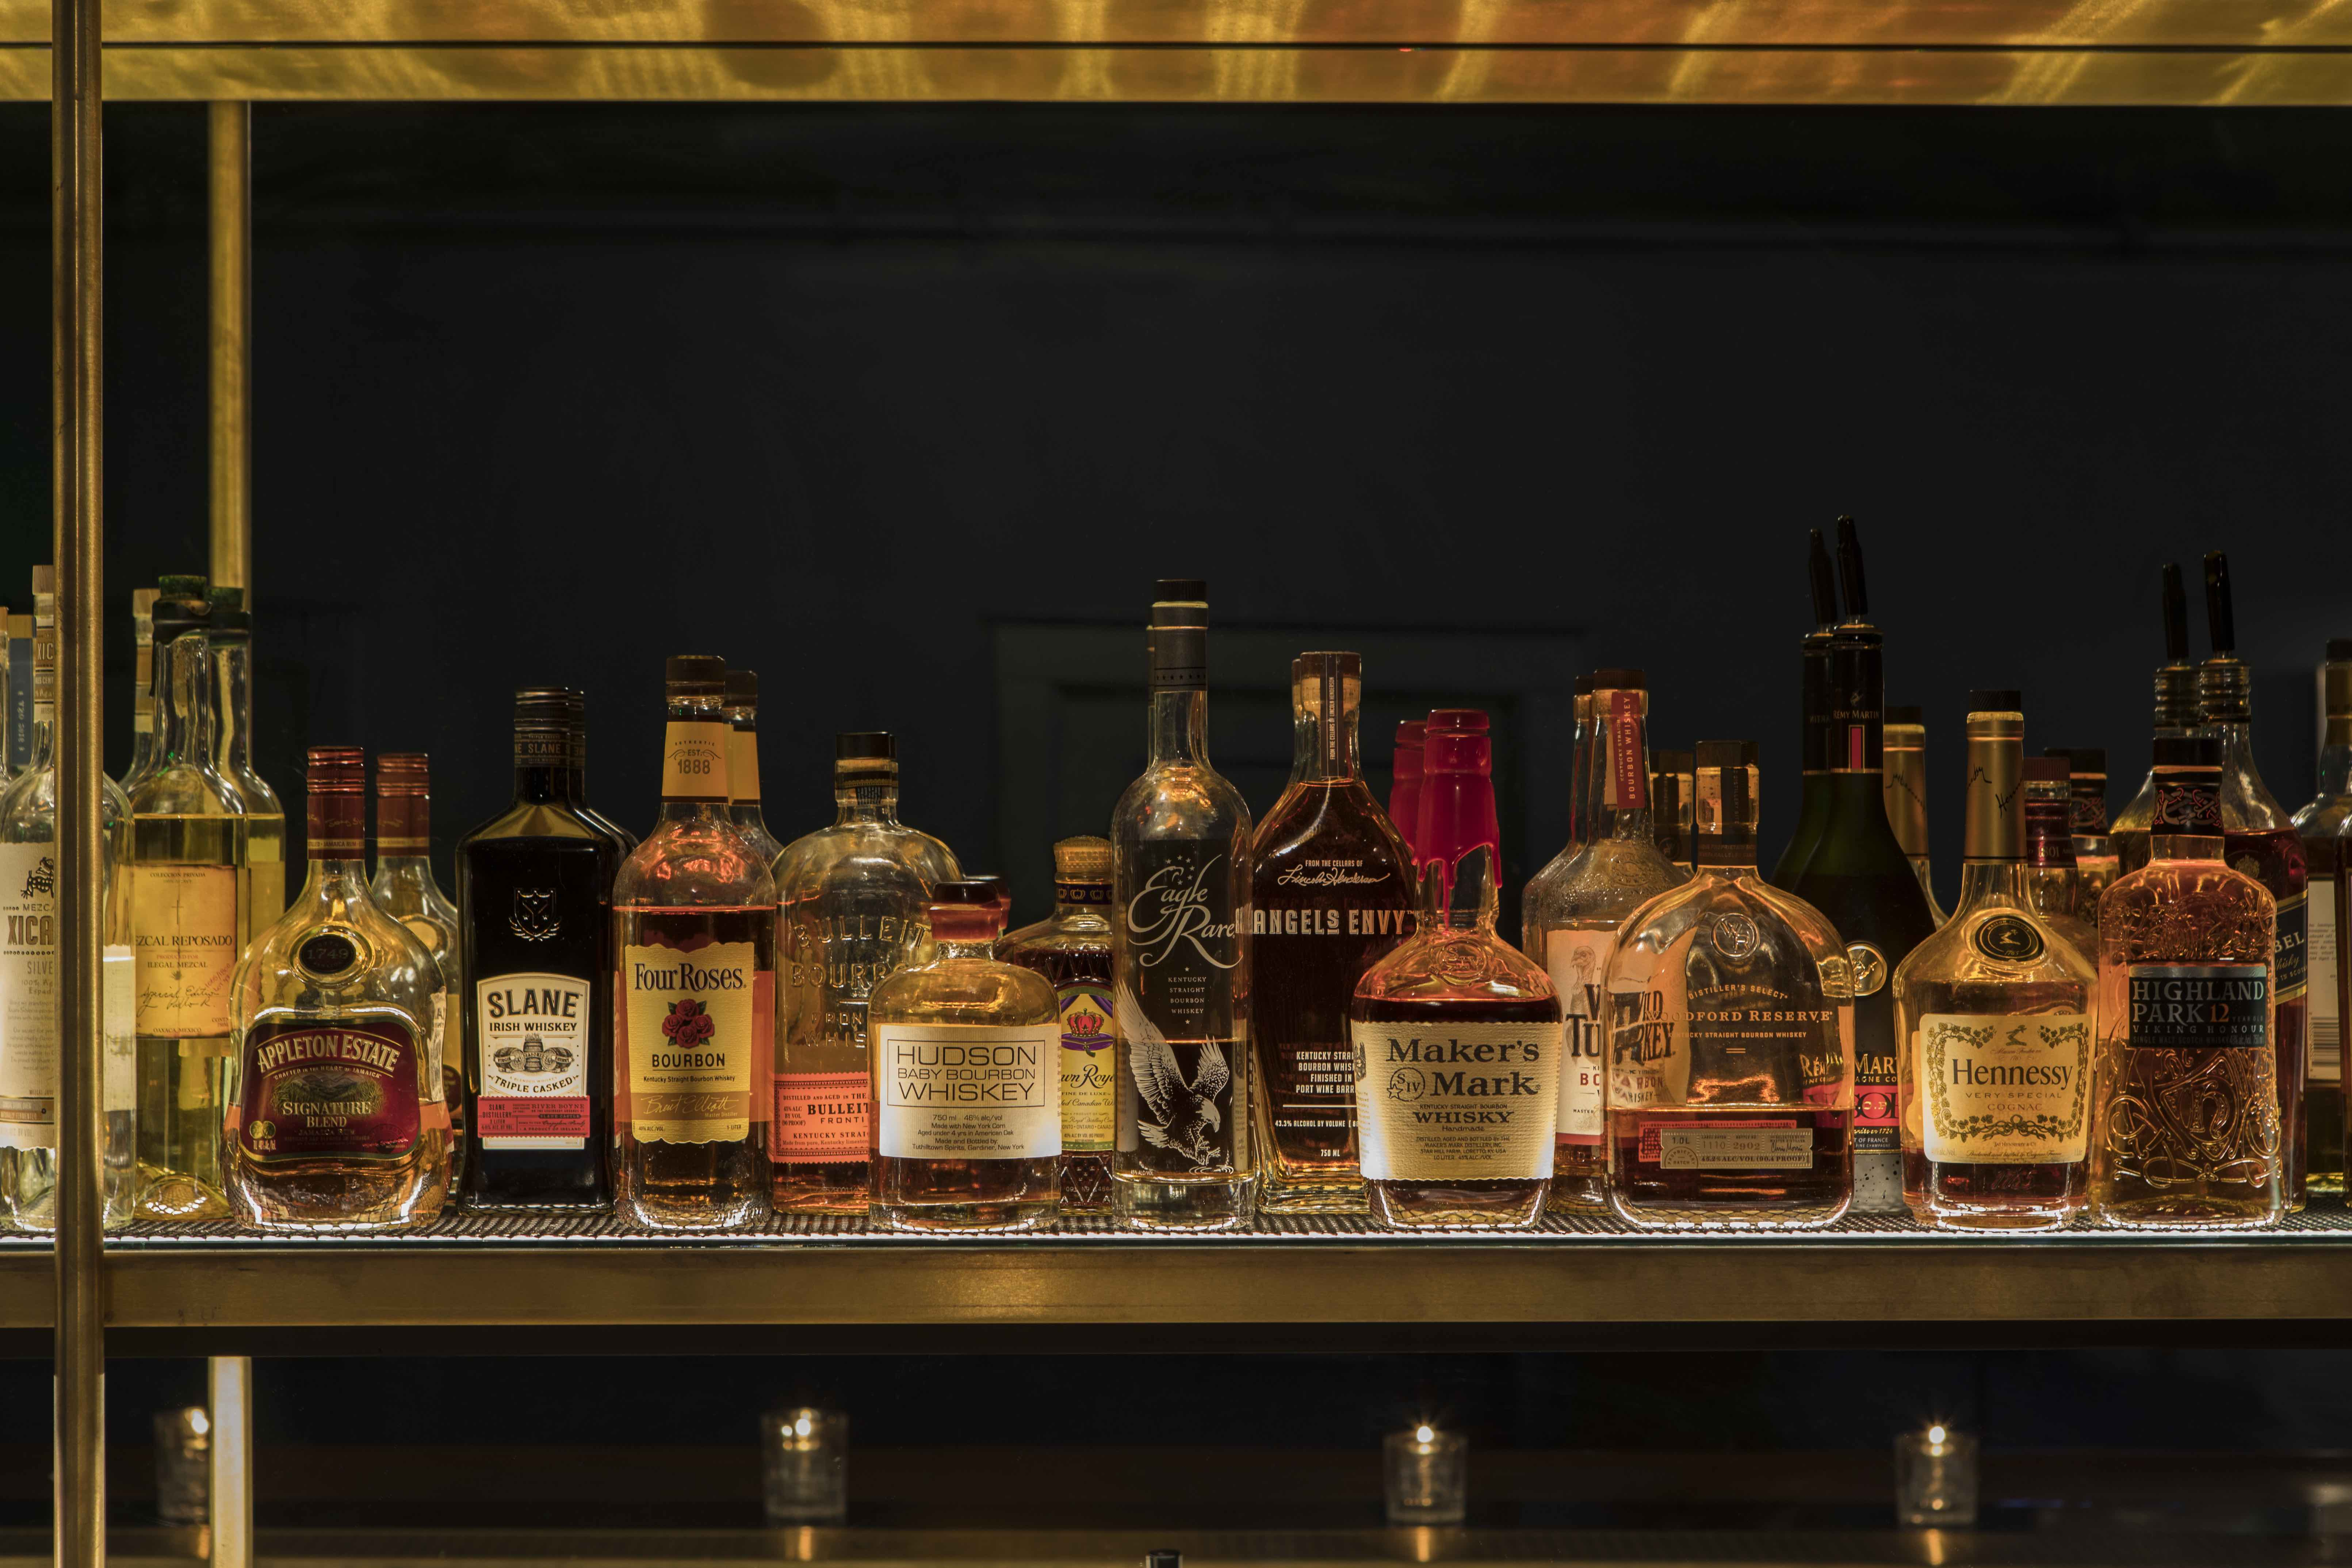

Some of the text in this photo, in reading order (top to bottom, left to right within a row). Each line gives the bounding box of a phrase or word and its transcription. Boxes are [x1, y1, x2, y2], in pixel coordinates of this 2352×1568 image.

[1852, 710, 1879, 719] MARTIN
[529, 743, 561, 753] SLANE
[1624, 698, 1636, 799] BOURBON WHISKEY
[677, 759, 711, 775] 1888
[1128, 854, 1223, 946] Eagle
[1253, 909, 1406, 935] ANGELS ENVY
[172, 935, 233, 946] REPOSADO
[1139, 905, 1244, 969] Rare
[306, 948, 349, 960] 1749
[635, 962, 743, 992] Four Roses
[1688, 984, 1785, 1000] DISTILLER'S SELECT
[2133, 981, 2264, 1001] HIGHLAND
[487, 988, 580, 1018] SLANE
[1644, 1010, 1830, 1022] WOODFORD RESERVE
[2133, 1003, 2204, 1026] PARK
[2211, 1003, 2230, 1022] 12
[489, 1022, 577, 1031] IRISH WHISKEY
[2133, 1025, 2264, 1033] VIKING HONOUR
[257, 1033, 401, 1074] APPLETON ESTATE
[897, 1045, 1036, 1066] HUDSON
[1296, 1051, 1331, 1060] KENTUCKY
[1385, 1038, 1540, 1063] Maker's
[652, 1052, 726, 1068] BOURBON
[1299, 1062, 1331, 1071] BOURBON
[898, 1067, 1036, 1081] BABY BOURBON
[1311, 1074, 1352, 1082] FINISHED IN
[1952, 1059, 2073, 1090] Hennessy
[494, 1075, 573, 1093] TRIPLE CASKED
[1296, 1085, 1334, 1094] PORT WINE
[1430, 1071, 1538, 1096] Mark
[898, 1082, 1035, 1101] WHISKEY
[282, 1101, 371, 1116] SIGNATURE
[807, 1102, 868, 1115] BULLEIT
[1072, 1098, 1102, 1106] Canadian
[1987, 1103, 2042, 1111] COGNAC
[306, 1116, 347, 1128] BLEND
[1413, 1111, 1514, 1124] WHISKY
[1702, 1141, 1726, 1150] 1110
[1733, 1142, 1760, 1150] 2902
[1320, 1149, 1340, 1157] 750 ML
